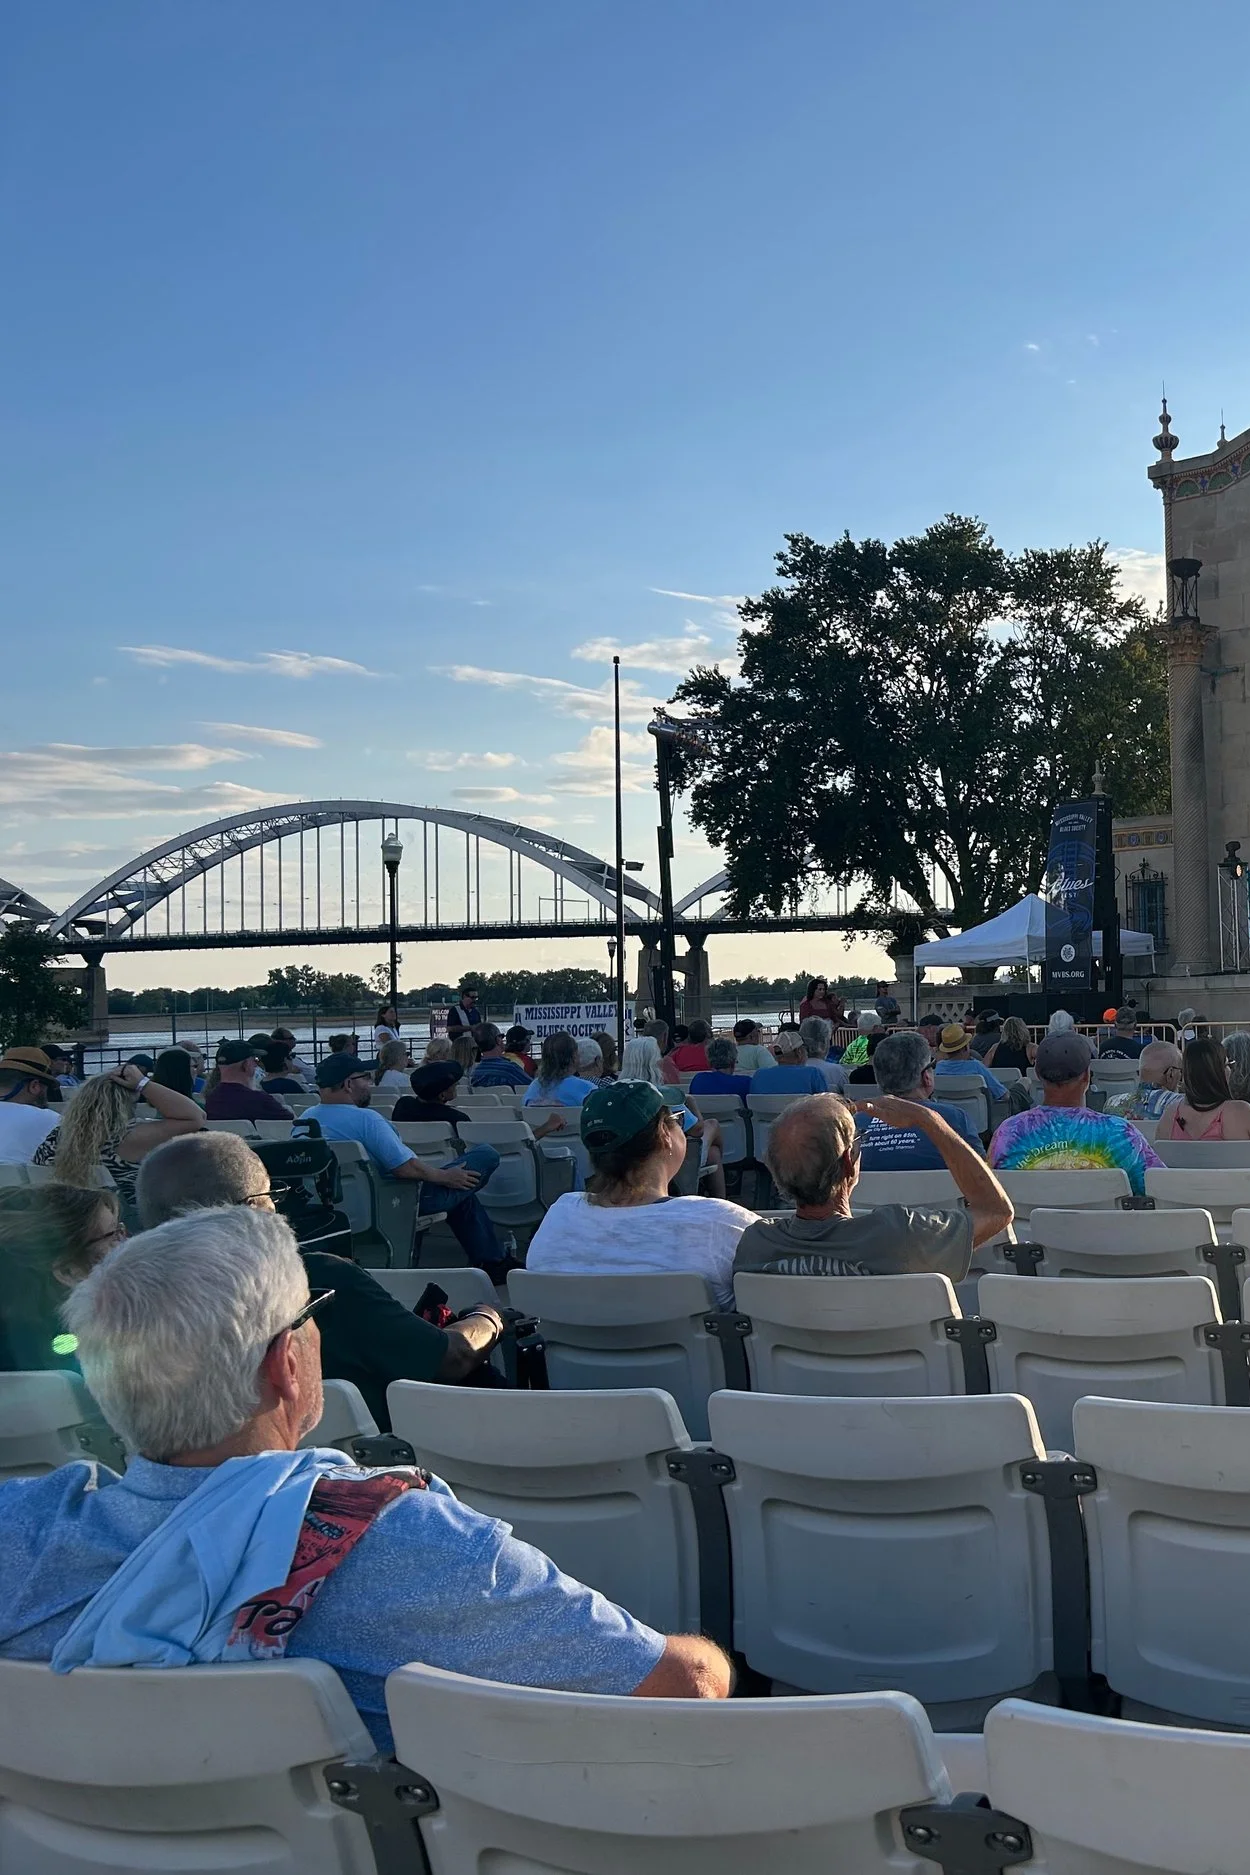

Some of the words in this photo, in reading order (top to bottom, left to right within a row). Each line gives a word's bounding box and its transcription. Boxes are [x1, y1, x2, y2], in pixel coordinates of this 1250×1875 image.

[1047, 877, 1094, 896] Blues
[1051, 970, 1085, 979] MVBS.ORG
[525, 1005, 582, 1021] MISSISSIPPI
[585, 1004, 618, 1018] VALLEY
[537, 1024, 565, 1038] BLUES
[567, 1023, 607, 1037] SOCIETY
[1031, 1140, 1068, 1157] Dream
